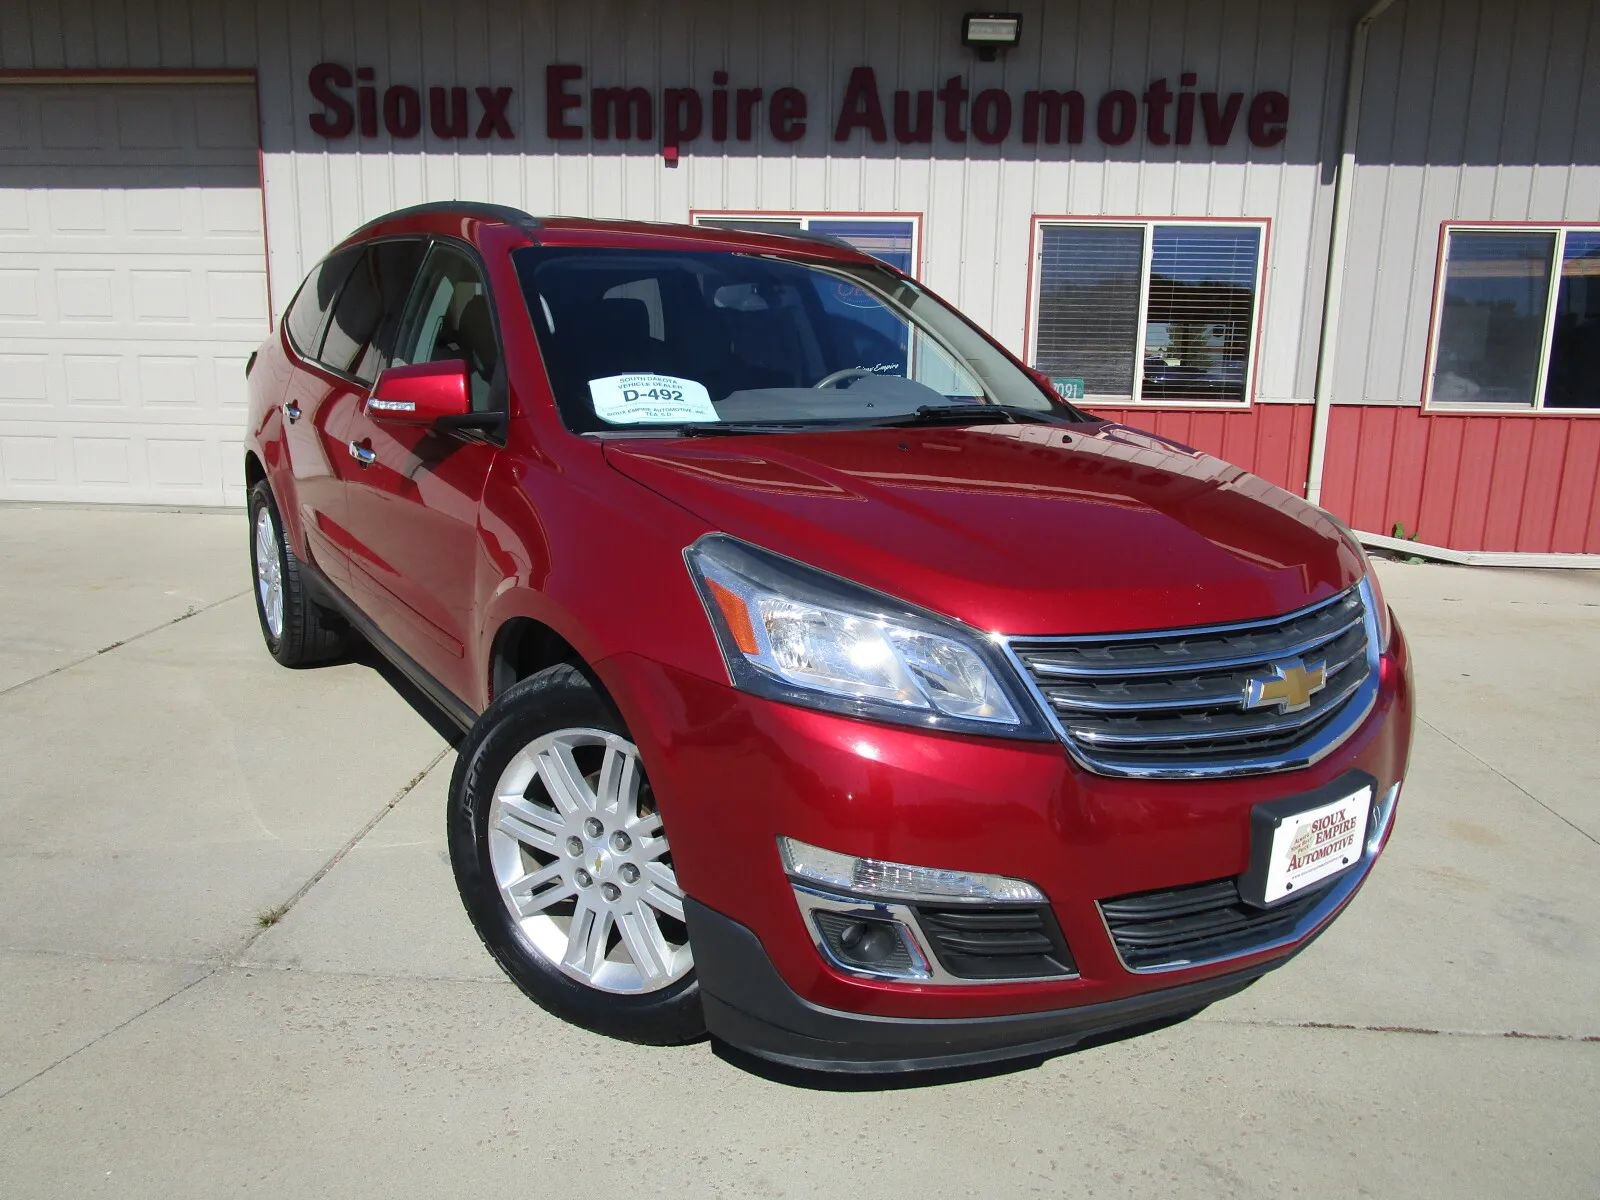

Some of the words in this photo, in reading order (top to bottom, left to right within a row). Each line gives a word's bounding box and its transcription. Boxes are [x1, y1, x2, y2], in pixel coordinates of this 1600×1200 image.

[308, 62, 515, 140] Sioux
[546, 65, 807, 168] Empire
[834, 67, 1289, 148] Automotive
[647, 376, 678, 384] DAKOTA
[652, 382, 683, 390] DEALER
[623, 388, 685, 402] D-492
[1311, 809, 1346, 833] SIOUX
[1315, 816, 1356, 844] EMPIRE
[1287, 834, 1354, 873] AUTOMOTIVE
